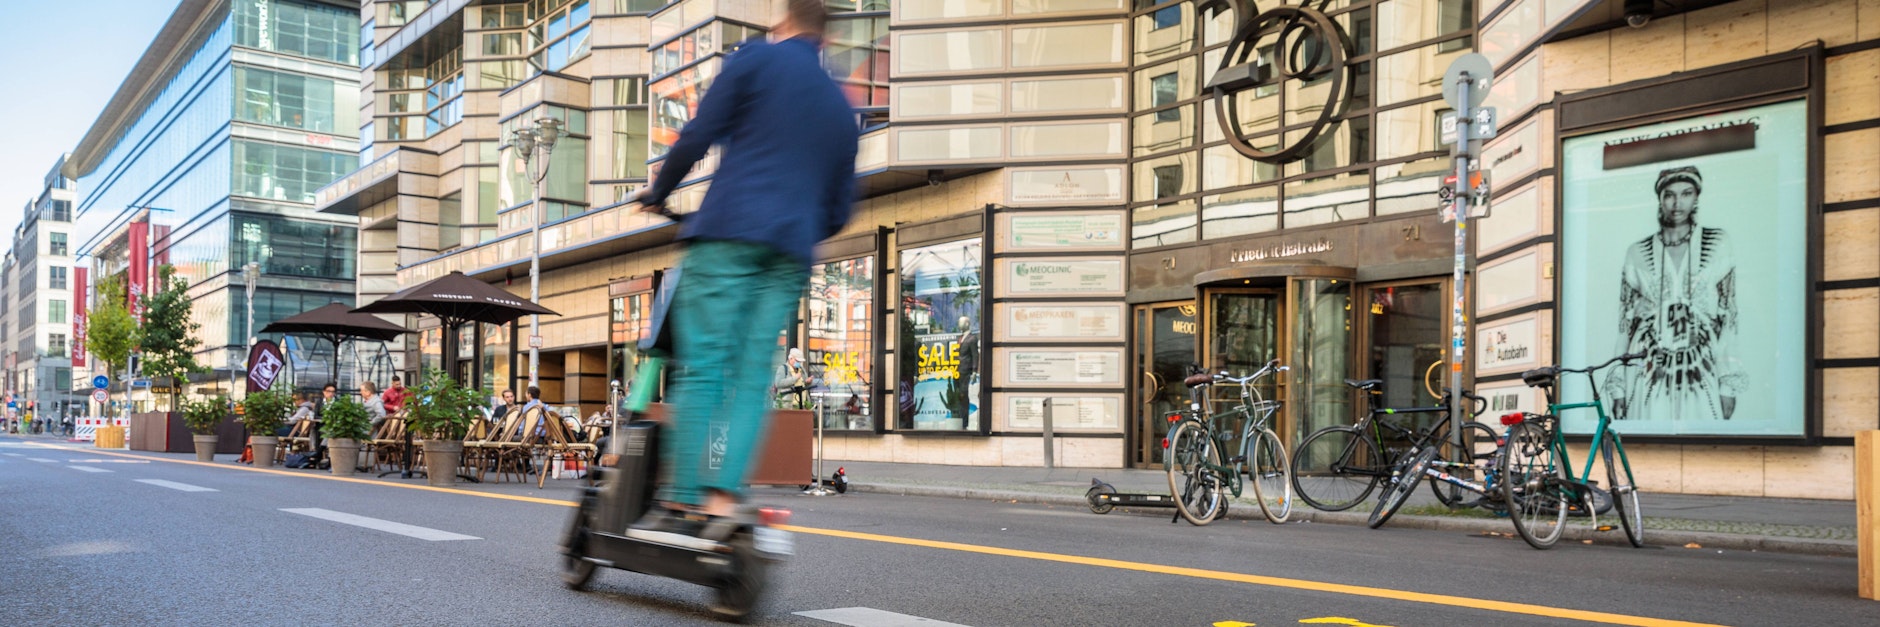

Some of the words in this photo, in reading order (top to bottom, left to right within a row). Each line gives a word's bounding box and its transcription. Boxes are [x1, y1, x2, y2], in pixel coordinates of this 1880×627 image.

[1402, 224, 1421, 241] 71
[1030, 265, 1072, 274] MEOCLINIC
[1161, 256, 1177, 271] 71
[1497, 330, 1507, 345] Die
[918, 344, 960, 367] SALE
[1497, 344, 1528, 361] Autobahn
[823, 351, 859, 372] SALE
